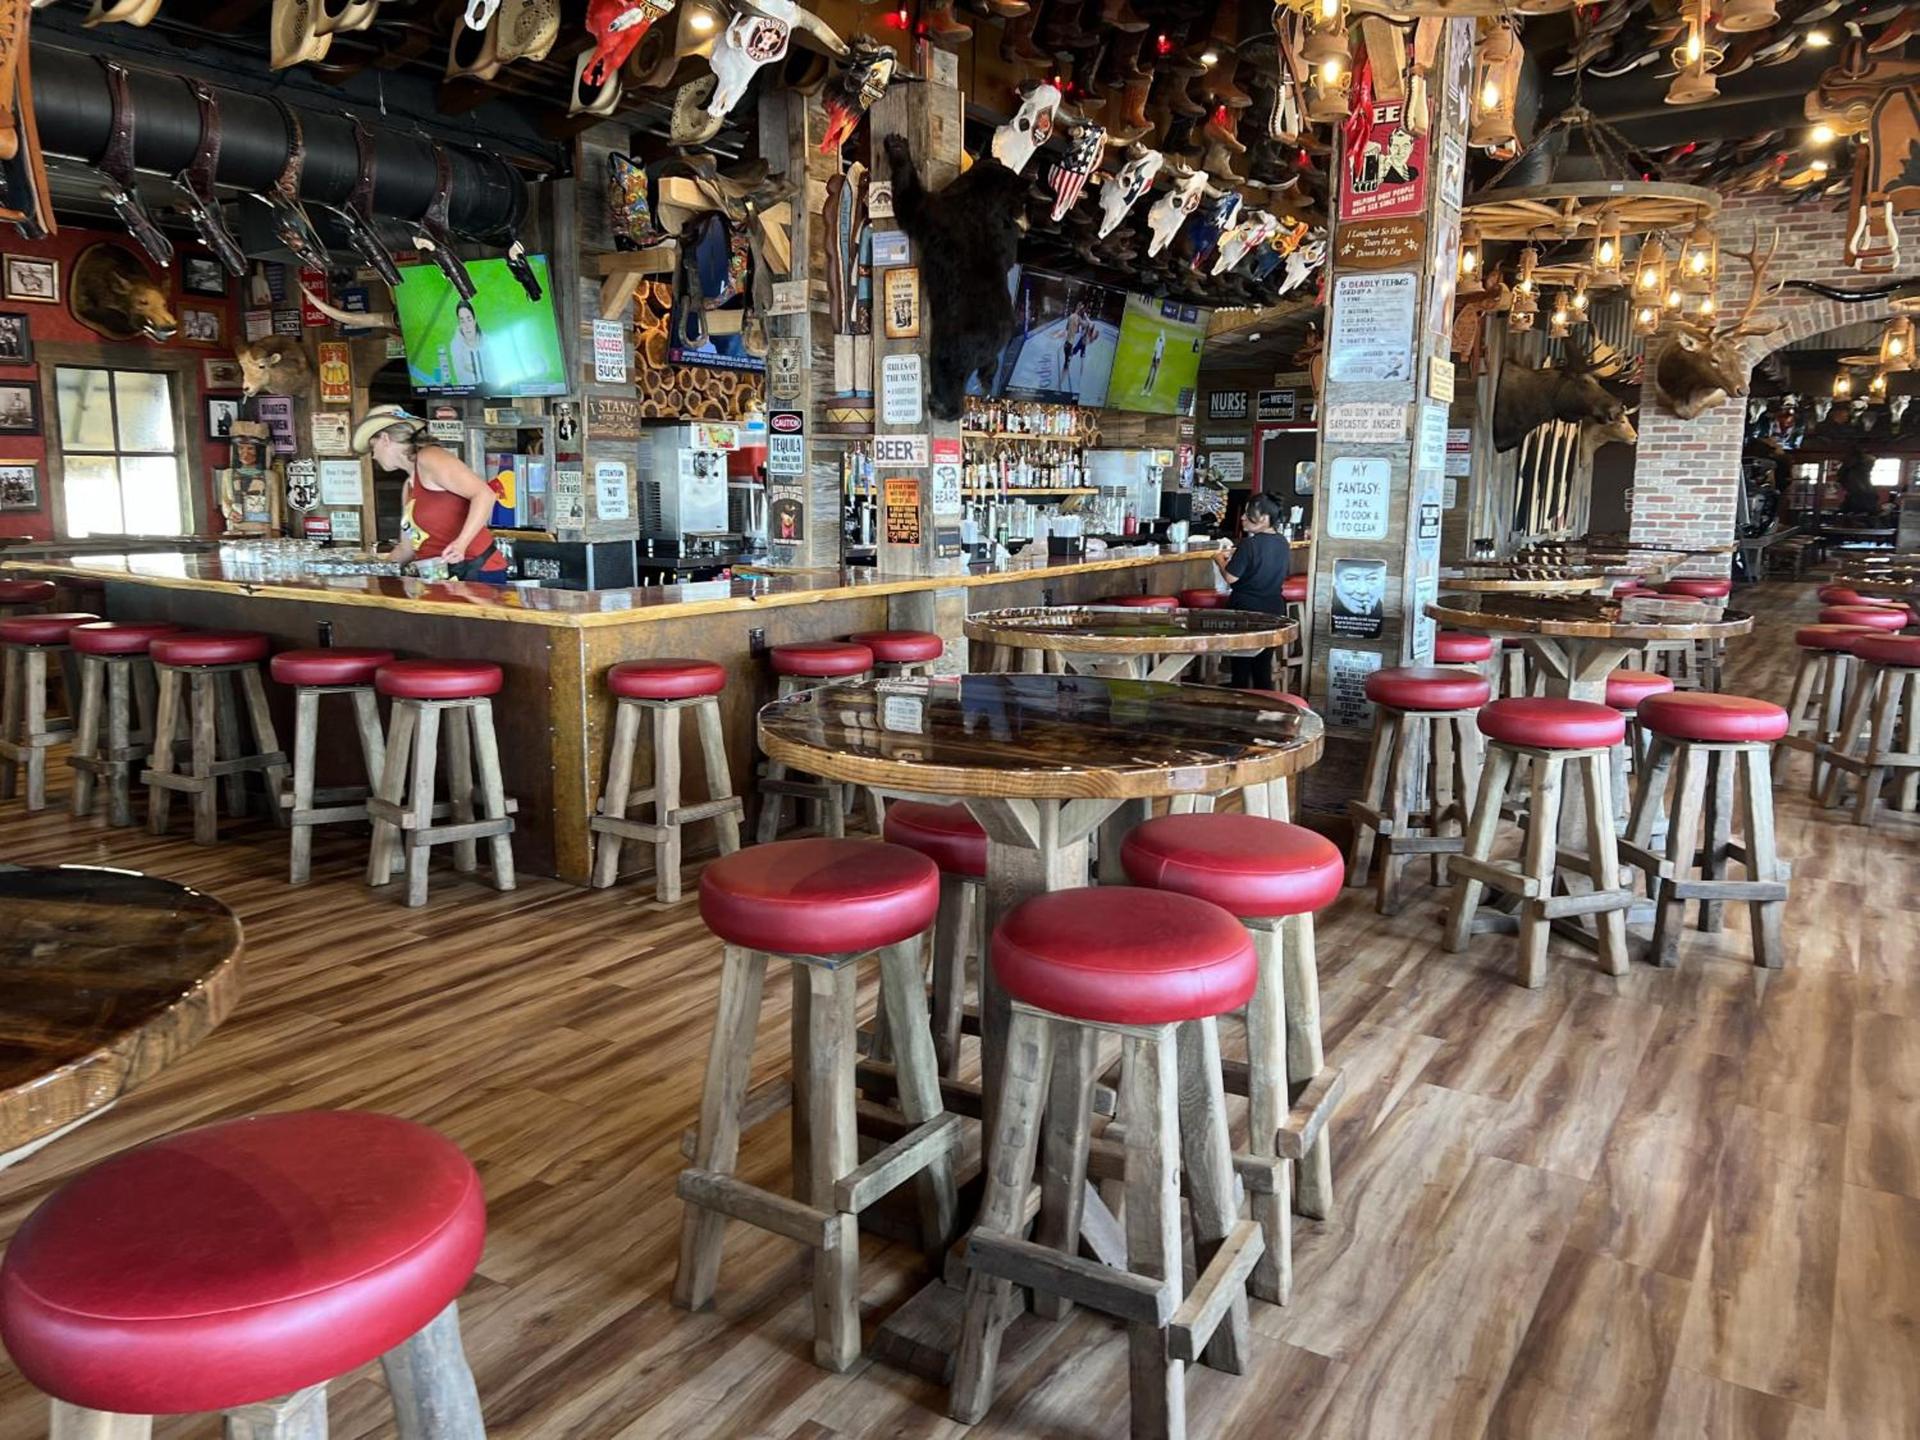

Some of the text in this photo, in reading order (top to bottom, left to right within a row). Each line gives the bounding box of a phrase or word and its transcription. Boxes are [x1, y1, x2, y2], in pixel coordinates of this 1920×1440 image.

[1349, 279, 1379, 289] DEADLY
[1382, 278, 1409, 286] TERMS
[595, 338, 622, 352] SUCCEED
[598, 365, 624, 379] SUCK
[885, 373, 918, 382] THE WEST
[599, 399, 637, 417] STAND
[1211, 392, 1247, 411] NURSE
[1329, 419, 1401, 429] SARCASTIC ANSWER
[772, 437, 801, 454] TEQUILA
[876, 440, 914, 460] BEER
[1352, 463, 1368, 477] MY
[1337, 481, 1381, 496] FANTASY:
[1351, 510, 1371, 520] COOK
[1353, 522, 1376, 532] CLEAN
